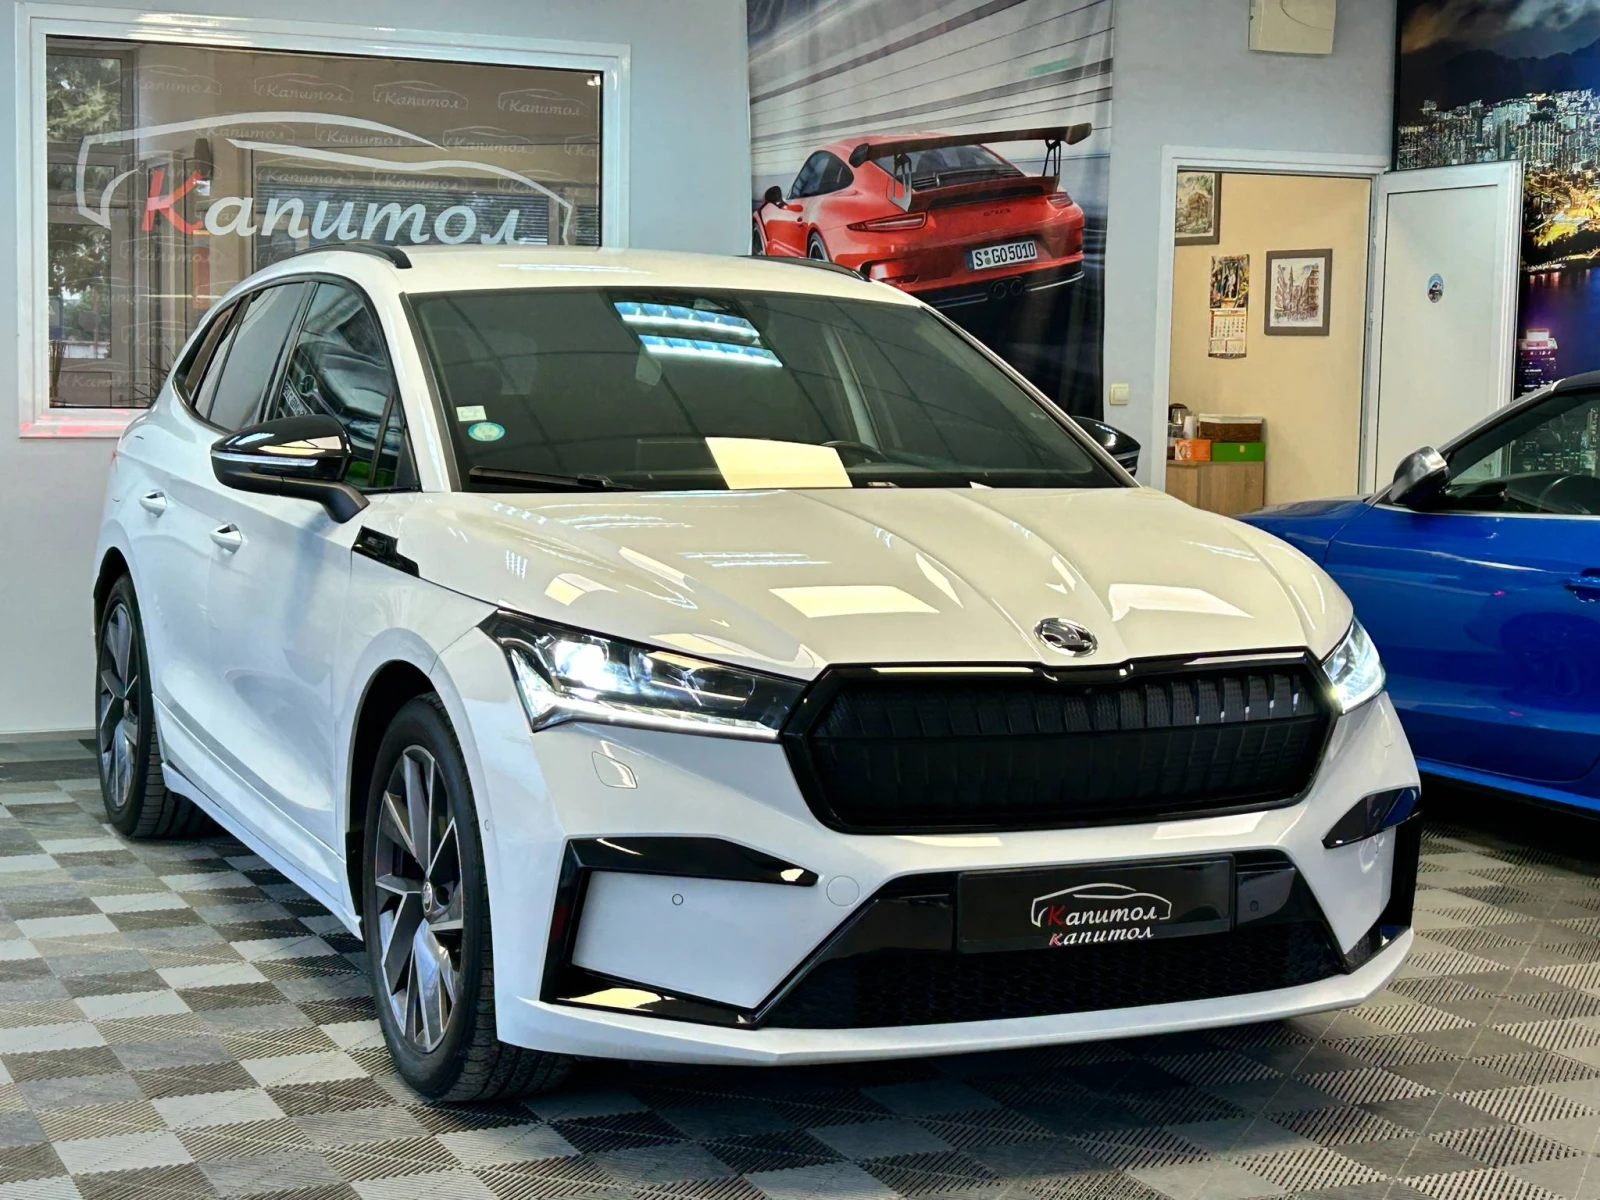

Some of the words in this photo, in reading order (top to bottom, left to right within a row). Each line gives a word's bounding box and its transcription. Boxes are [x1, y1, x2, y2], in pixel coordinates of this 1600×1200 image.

[265, 82, 344, 102] Капитол
[384, 89, 462, 109] Капитол
[506, 98, 582, 117] Капитол
[140, 169, 519, 246] Капитол
[1048, 905, 1157, 926] Капитол
